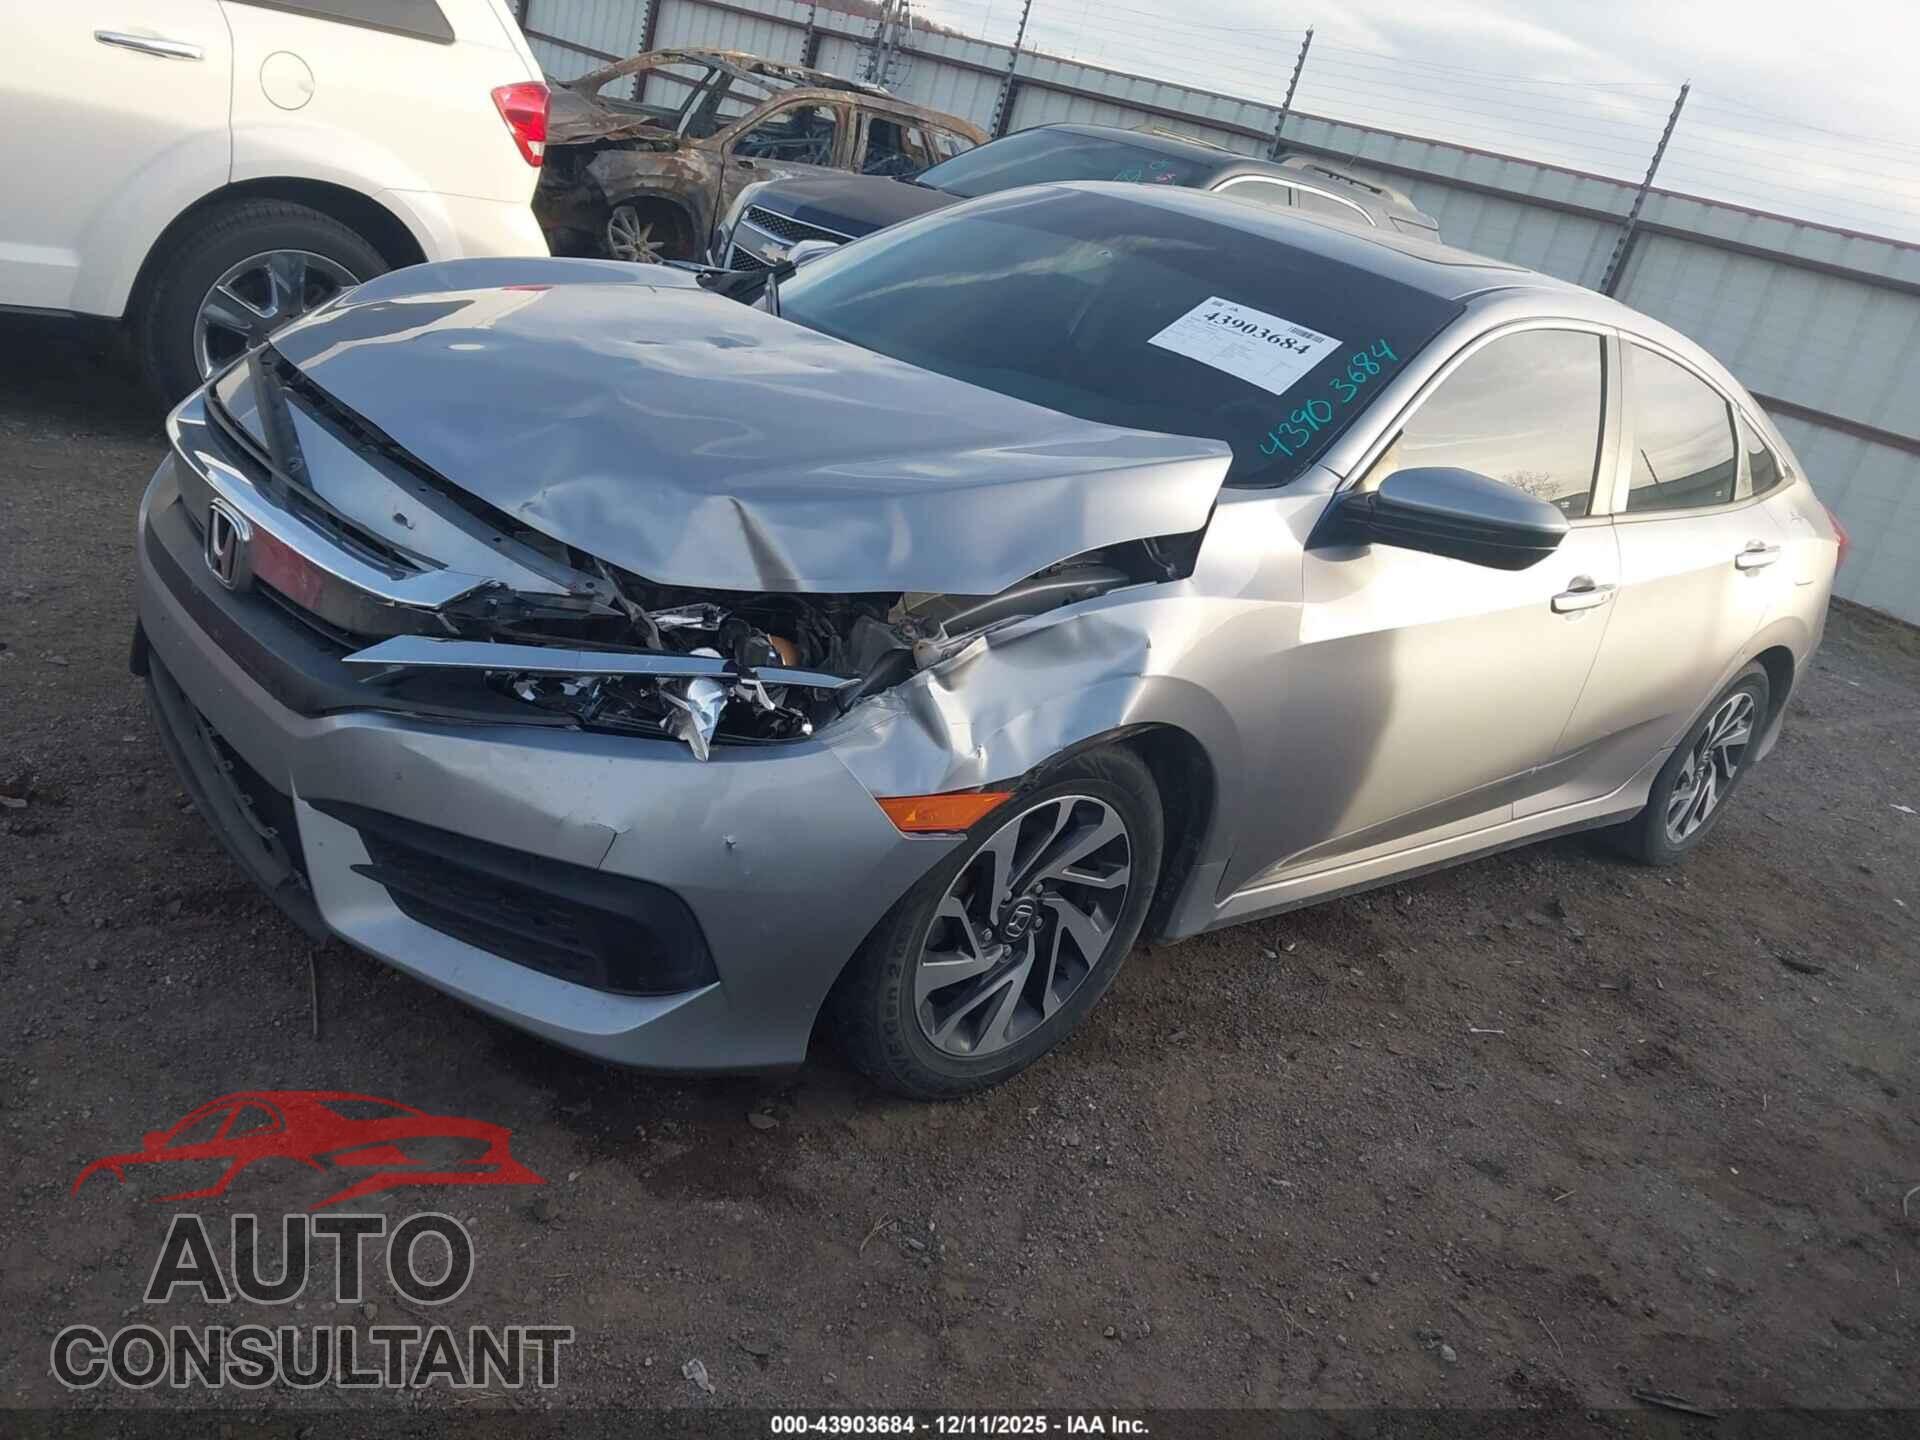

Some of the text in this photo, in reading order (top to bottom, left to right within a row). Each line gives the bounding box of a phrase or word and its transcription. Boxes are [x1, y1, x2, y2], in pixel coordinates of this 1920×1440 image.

[1203, 311, 1312, 355] 43903684
[1260, 338, 1399, 457] 4390 3684
